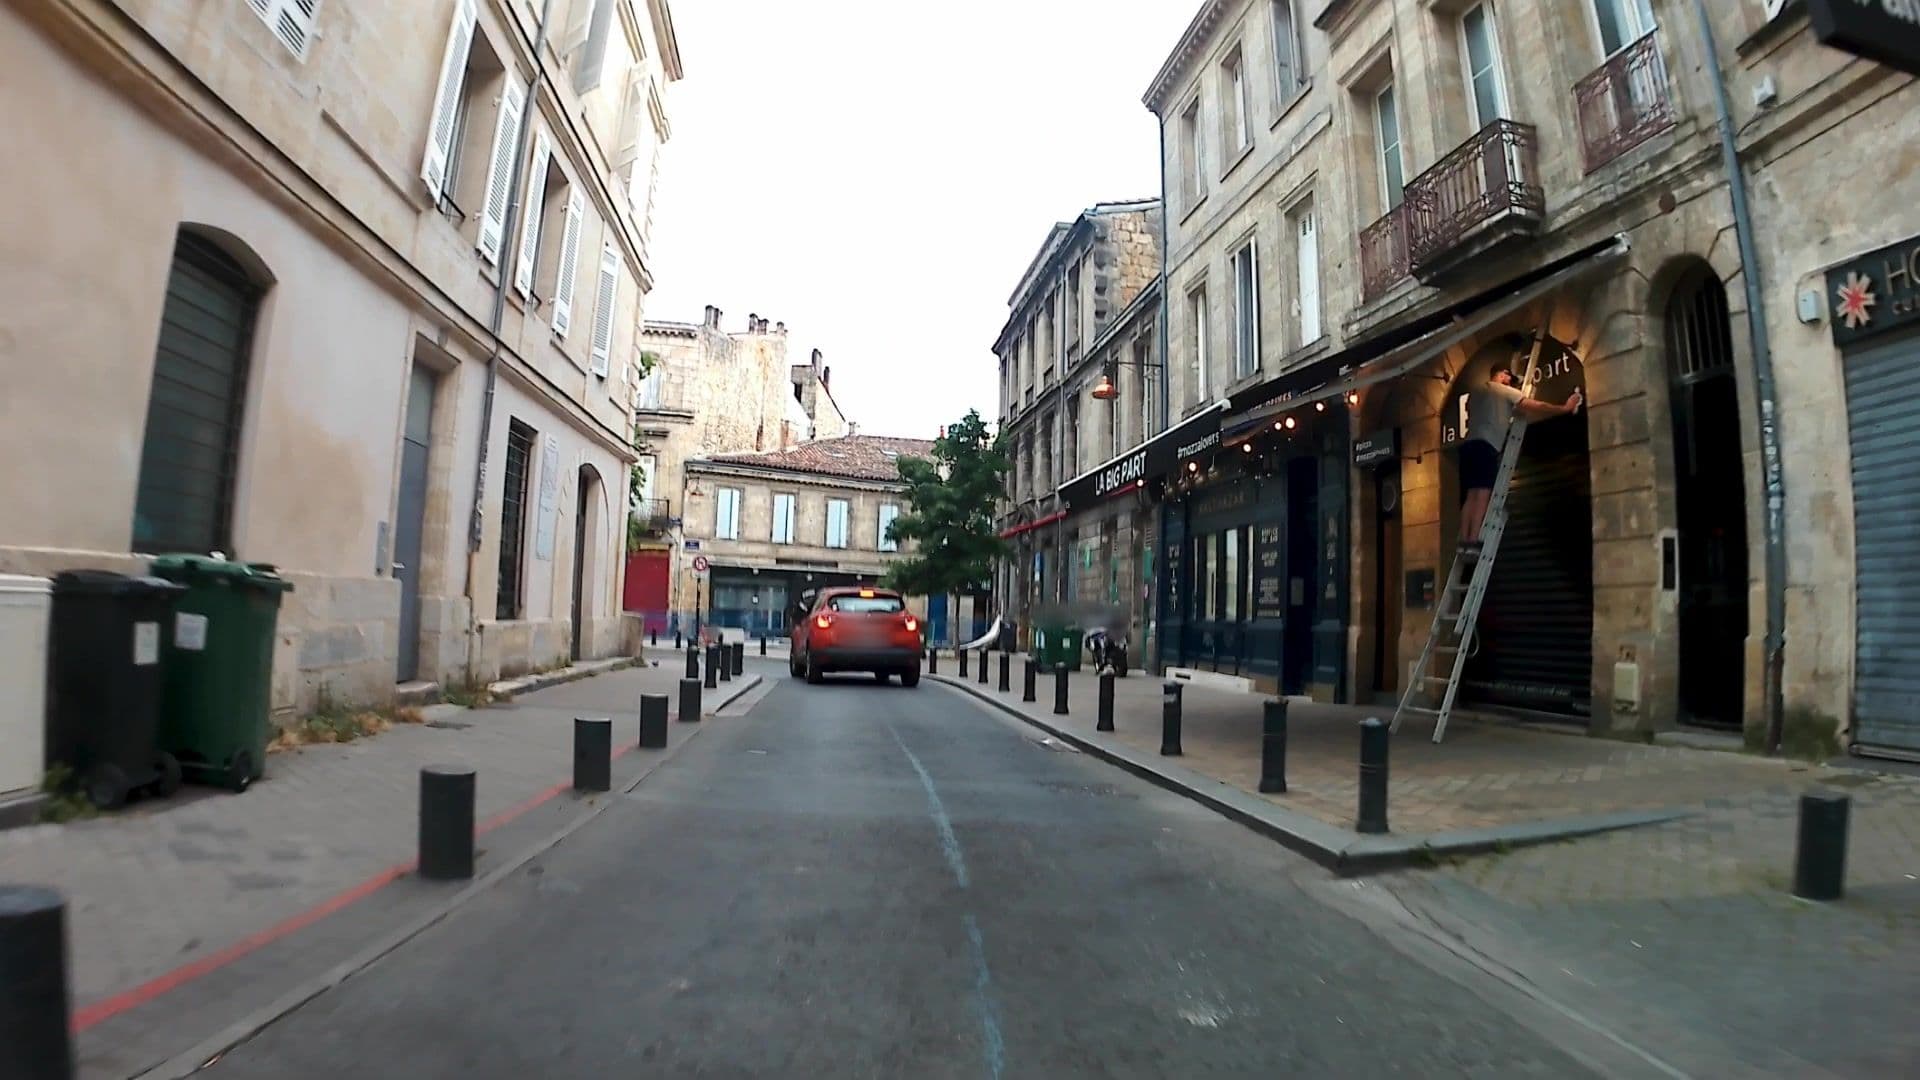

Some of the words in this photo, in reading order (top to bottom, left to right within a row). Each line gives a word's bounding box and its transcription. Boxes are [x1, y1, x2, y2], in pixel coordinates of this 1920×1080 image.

[1442, 425, 1456, 443] la
[1095, 472, 1105, 496] LA
[1106, 465, 1120, 491] BIG
[1121, 450, 1147, 483] PART
